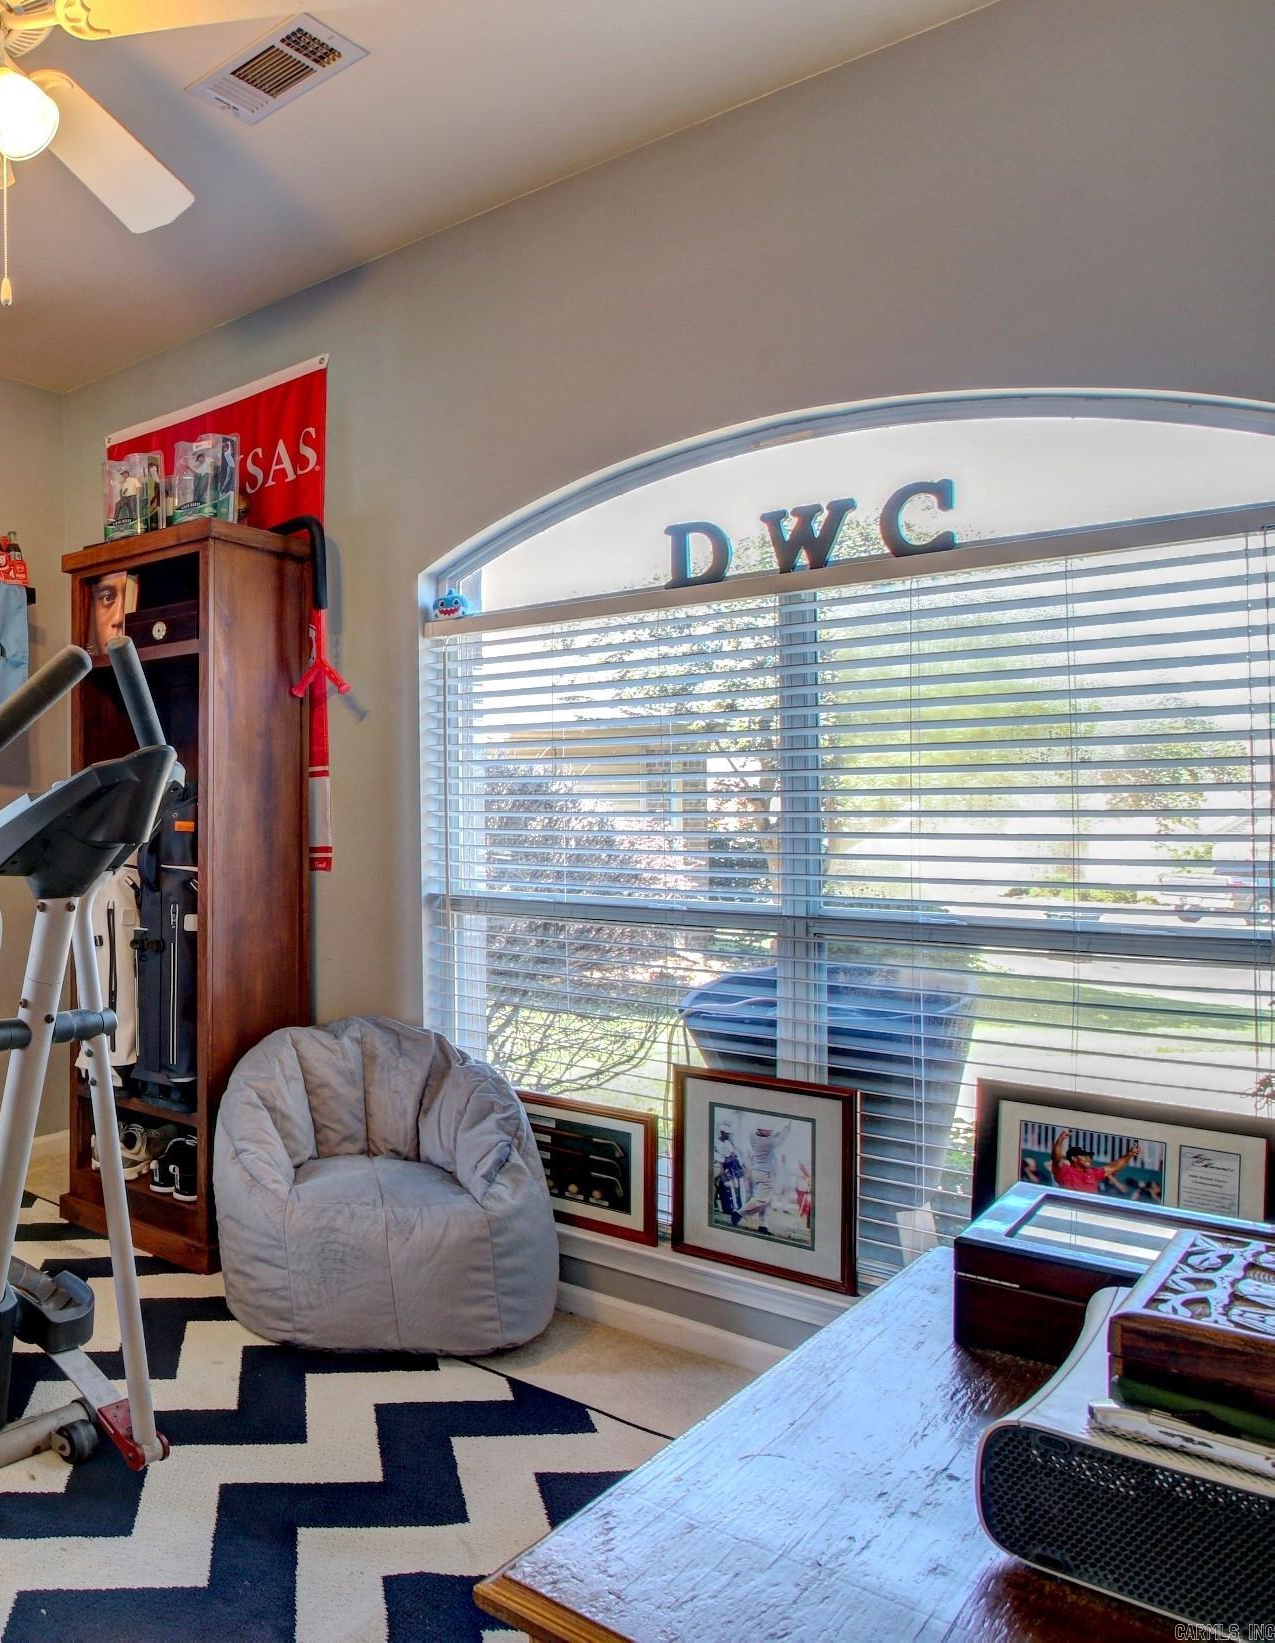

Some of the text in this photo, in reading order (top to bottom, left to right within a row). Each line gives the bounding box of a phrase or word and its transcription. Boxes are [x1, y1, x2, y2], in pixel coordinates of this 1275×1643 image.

[240, 427, 318, 494] SAS
[664, 478, 959, 589] D W C
